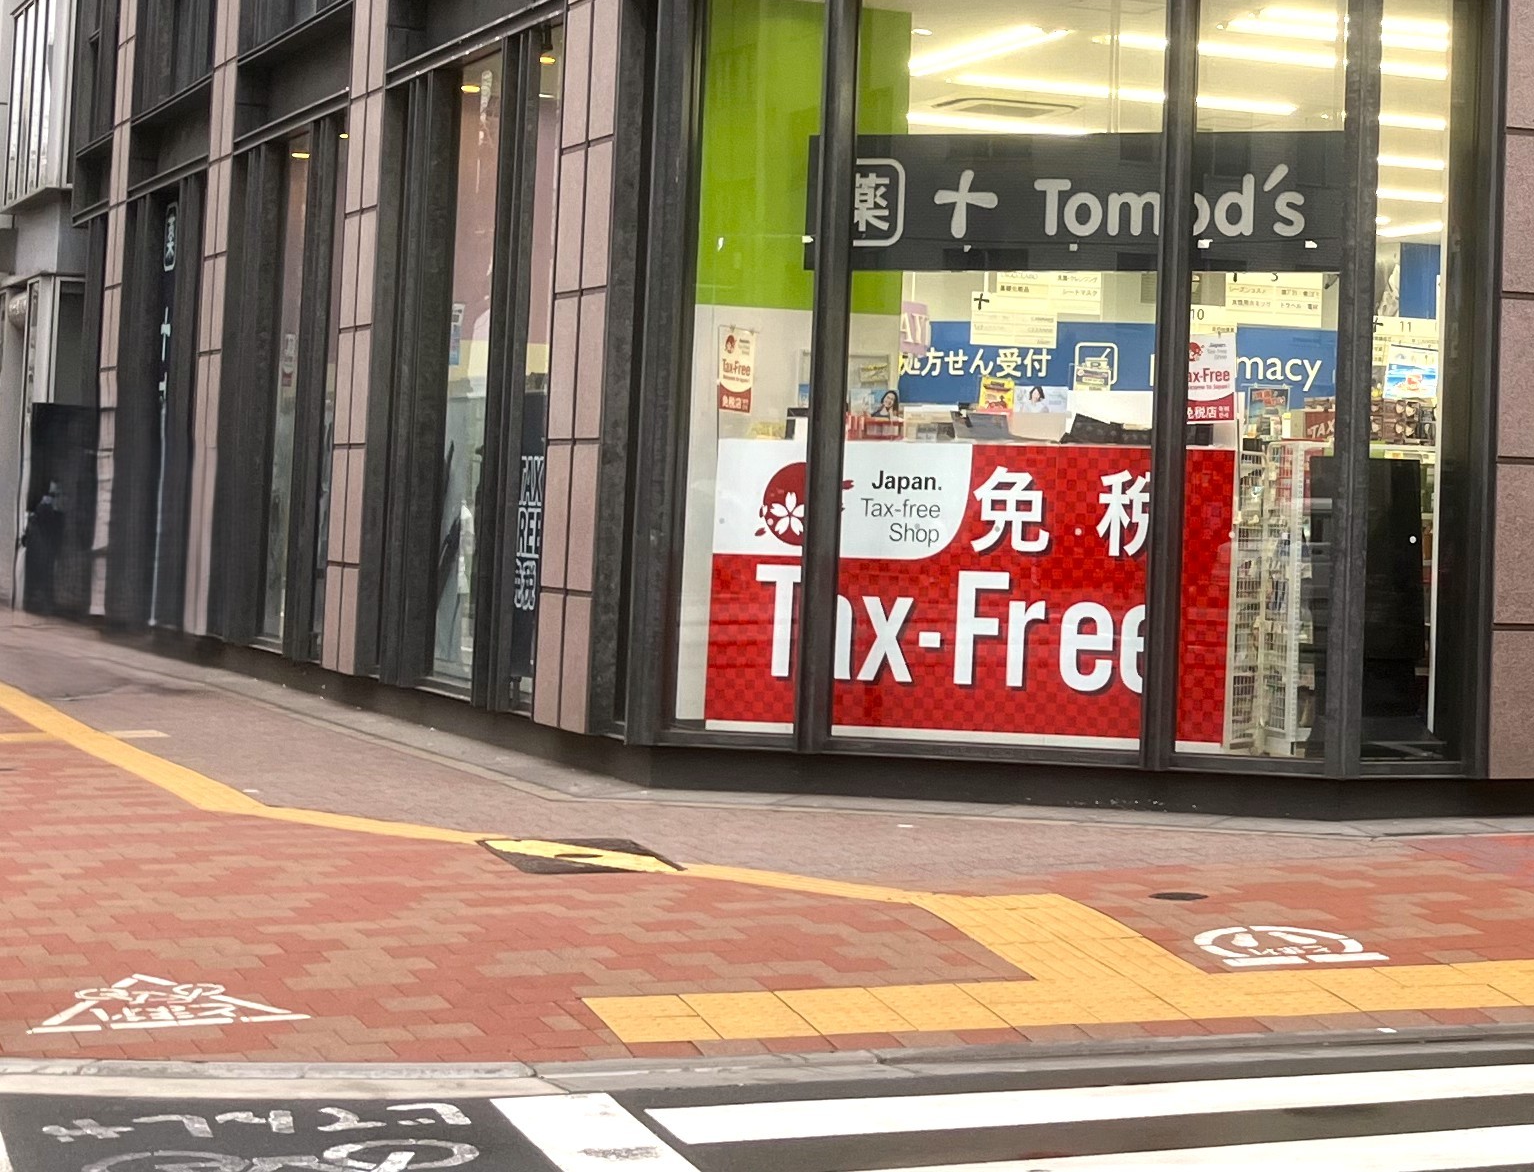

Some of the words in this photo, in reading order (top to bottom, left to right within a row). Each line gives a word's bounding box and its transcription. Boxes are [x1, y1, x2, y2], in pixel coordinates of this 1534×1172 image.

[1400, 320, 1412, 333] 11
[900, 348, 1052, 379] 処方せん受付
[1188, 368, 1230, 384] ax-Free
[872, 470, 942, 495] Japan.
[861, 497, 941, 519] Tax-free
[516, 507, 542, 559] REE
[889, 522, 940, 547] Shop
[43, 1102, 472, 1142] じてんしゃ
